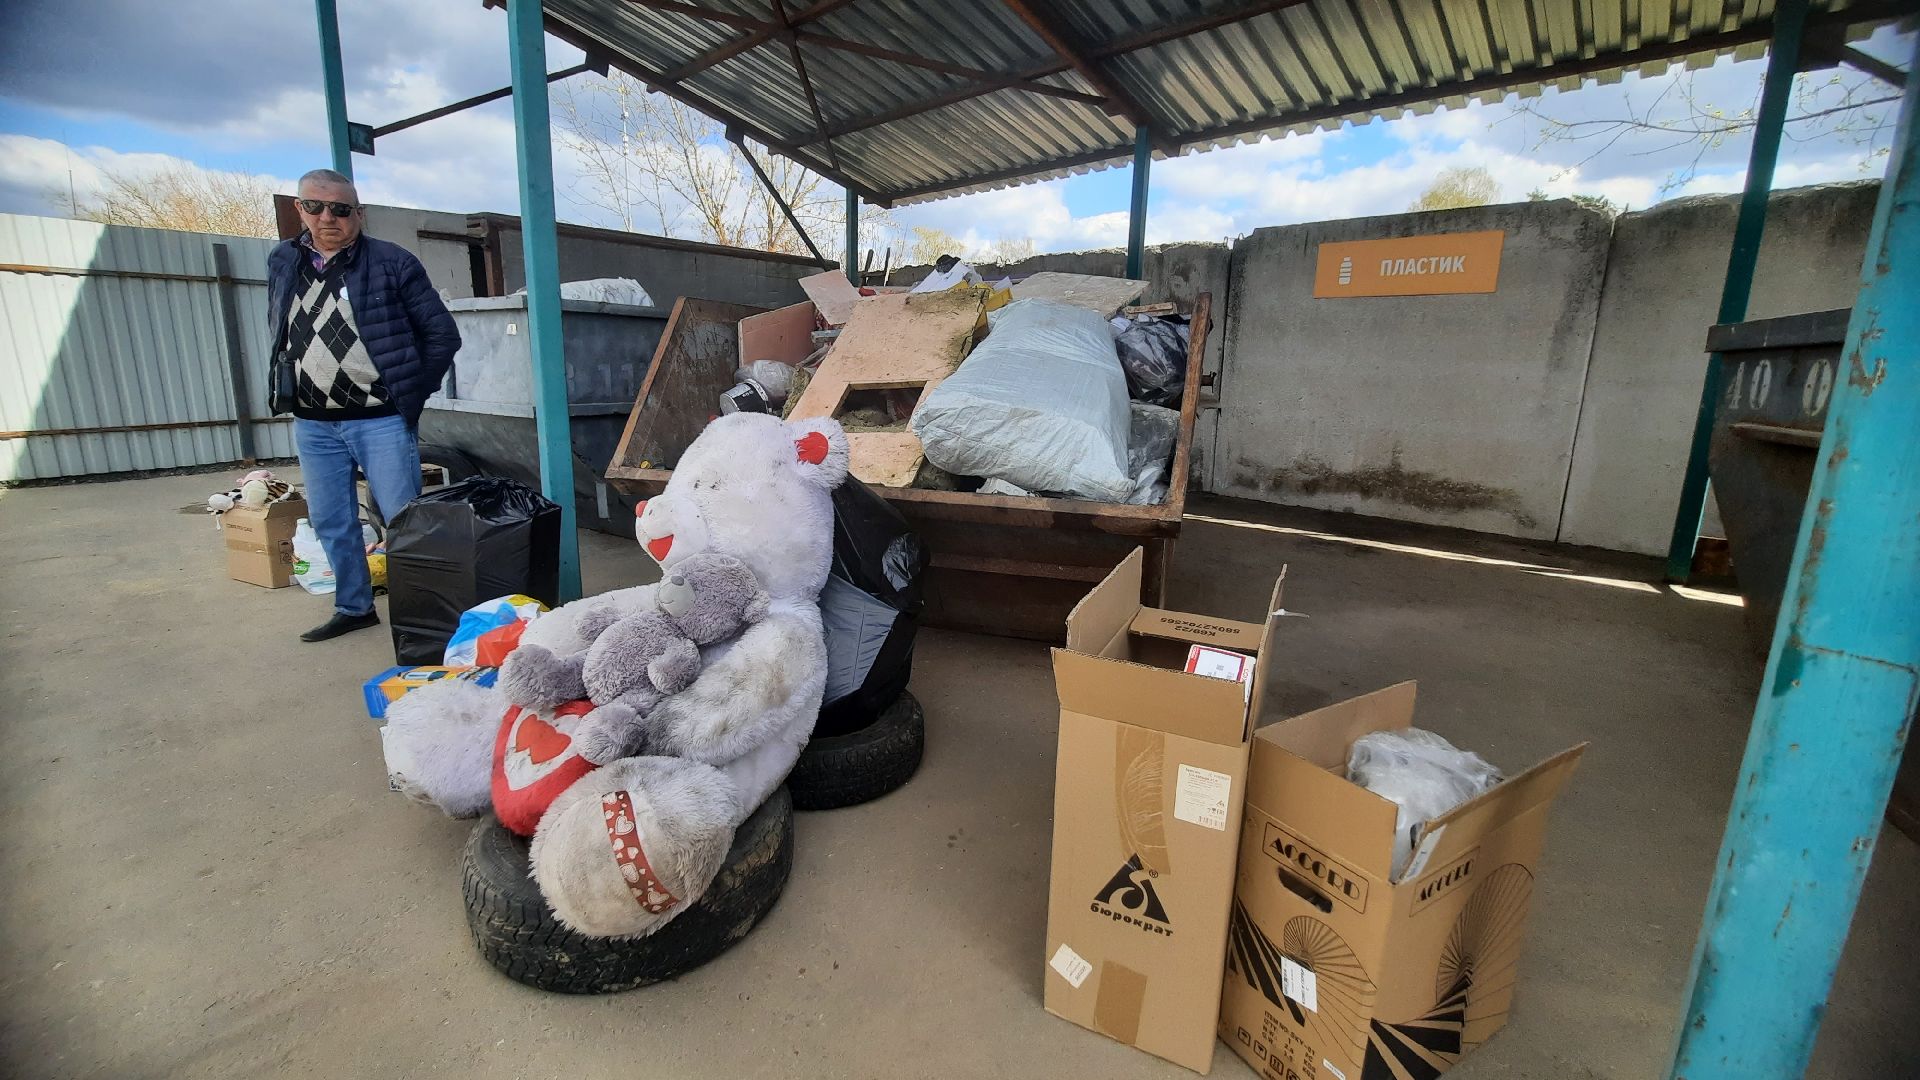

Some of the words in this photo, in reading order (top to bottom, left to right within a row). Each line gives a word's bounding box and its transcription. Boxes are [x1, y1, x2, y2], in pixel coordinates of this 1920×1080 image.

[1379, 255, 1467, 277] ПЛАСТИК
[1268, 836, 1360, 900] ACCORD
[1415, 857, 1475, 903] ACCORD
[1090, 902, 1174, 937] бюрократ
